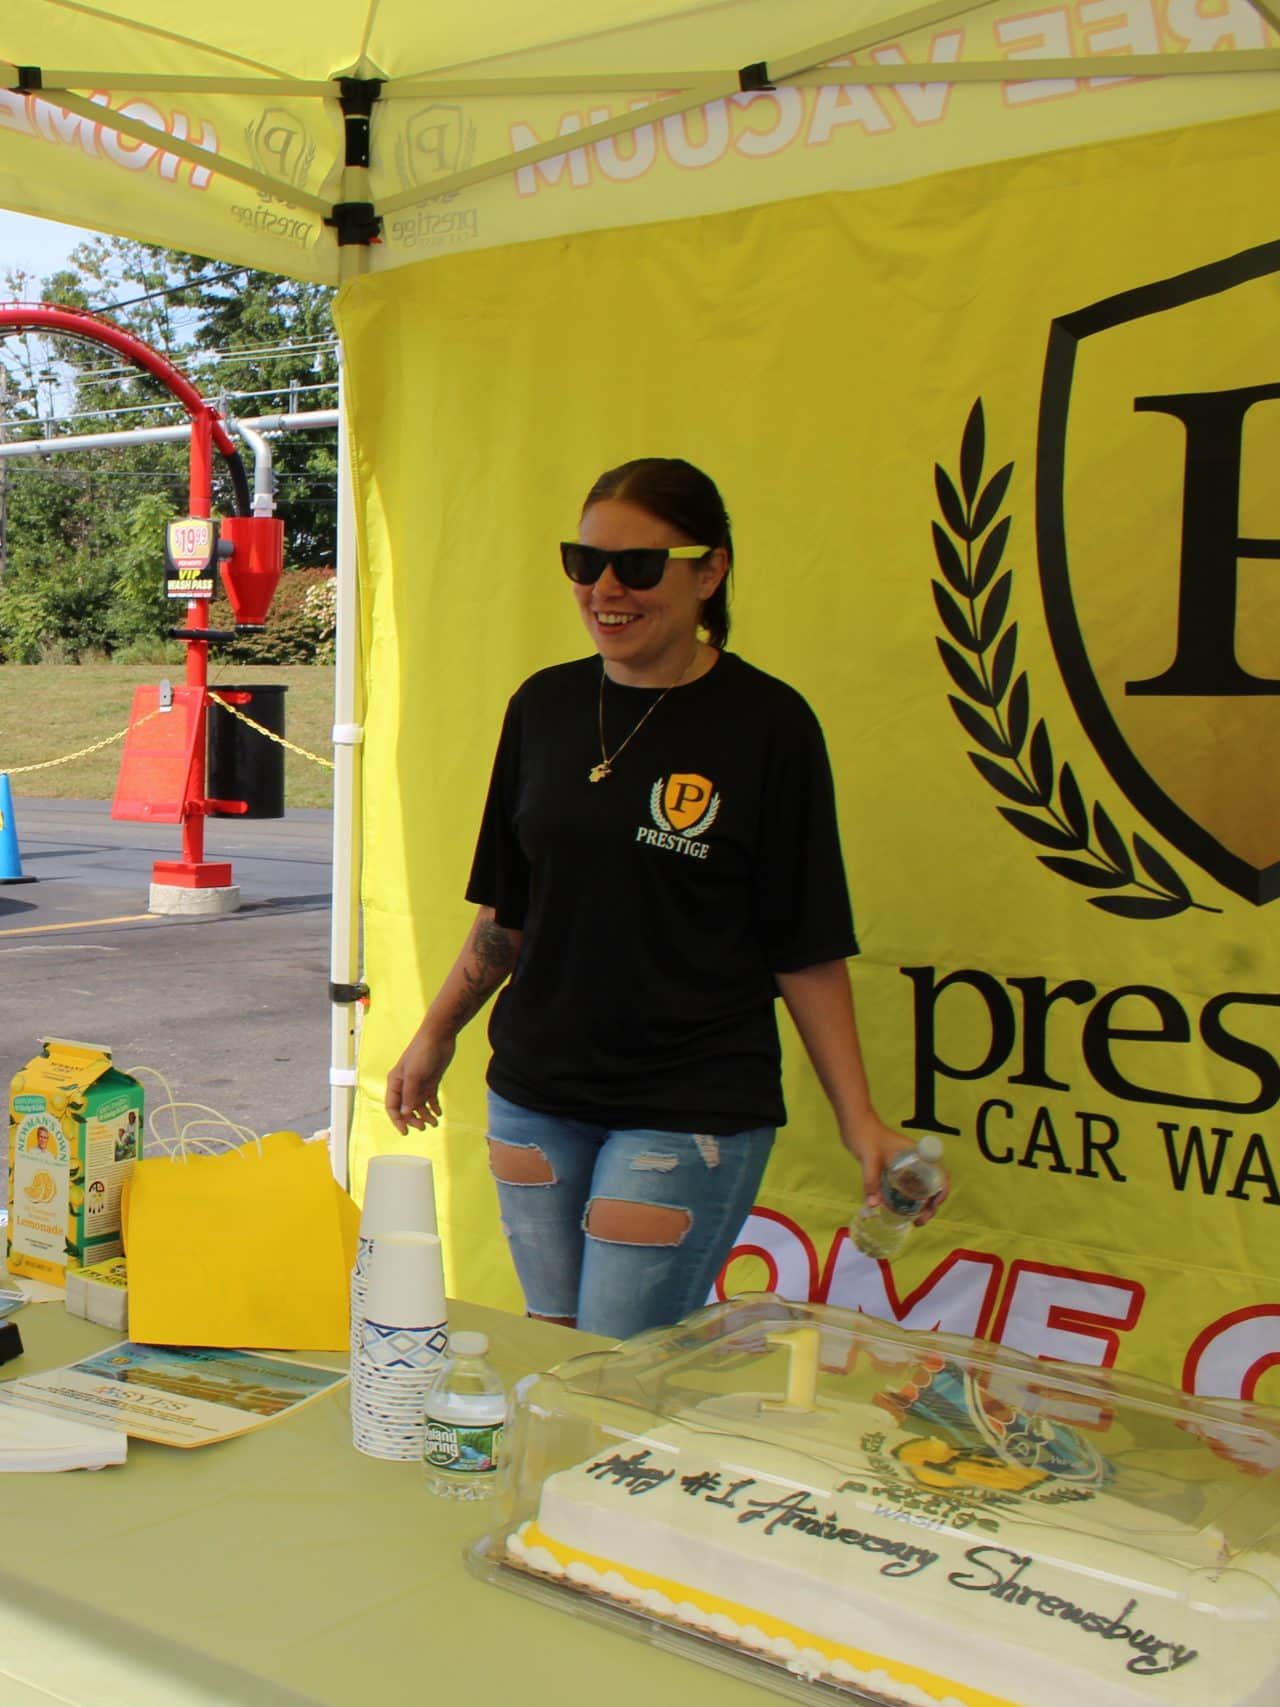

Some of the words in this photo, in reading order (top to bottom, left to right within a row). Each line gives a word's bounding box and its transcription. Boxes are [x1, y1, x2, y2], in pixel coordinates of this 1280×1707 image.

[179, 569, 201, 580] VIP
[668, 782, 705, 813] P
[635, 826, 711, 860] PRESTIGE
[899, 964, 1280, 1136] pres
[976, 1099, 1126, 1182] CAR
[1157, 1121, 1280, 1206] WA
[16, 1216, 65, 1237] Lemonade
[948, 1545, 1199, 1676] Shrewsbury
